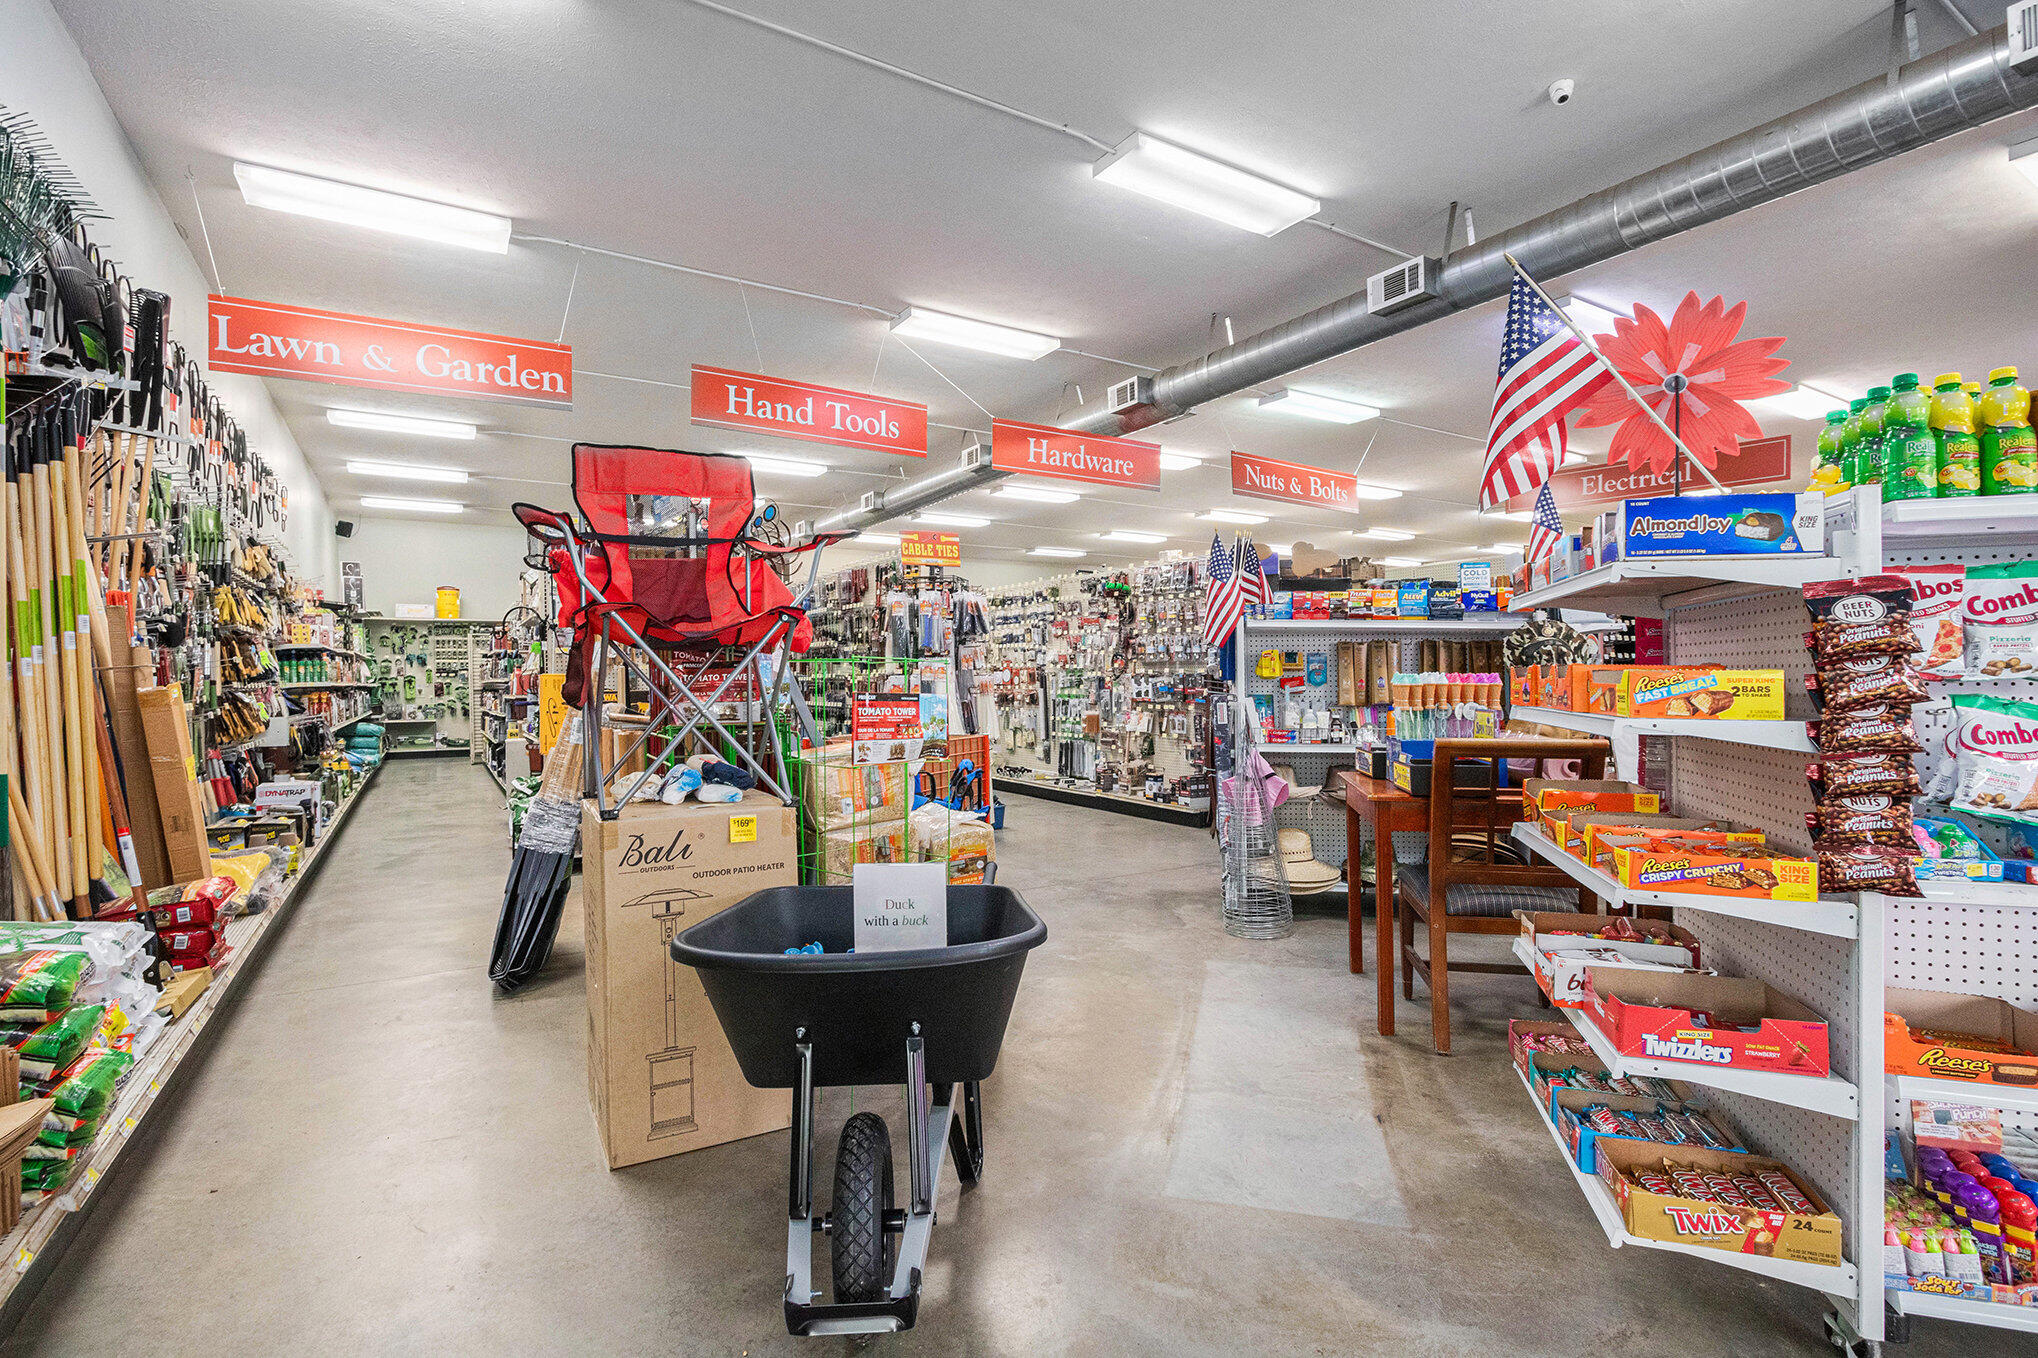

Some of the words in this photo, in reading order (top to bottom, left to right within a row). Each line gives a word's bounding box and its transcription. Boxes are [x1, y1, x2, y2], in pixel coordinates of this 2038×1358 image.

[211, 314, 342, 367] Lawn
[361, 345, 398, 373] &
[415, 343, 568, 394] Garden
[725, 384, 815, 427] Hand
[825, 401, 900, 440] Tools
[1027, 437, 1134, 477] Hardware
[1243, 463, 1285, 492] Nuts
[1289, 475, 1304, 494] &
[1308, 476, 1349, 503] Bolts
[1580, 462, 1692, 497] Electrical
[1630, 515, 1700, 537] Almond
[1699, 514, 1733, 535] Joy
[902, 542, 934, 556] CABLE
[935, 544, 959, 557] TIES
[1911, 577, 1964, 601] bos
[1842, 601, 1873, 611] BEER
[1844, 607, 1876, 619] NUTS
[1925, 603, 1951, 616] SNACKS
[1839, 626, 1892, 644] Peanuts
[1845, 624, 1877, 635] Original
[1635, 672, 1687, 694] Reese's
[1850, 674, 1900, 692] Peanuts
[1854, 672, 1886, 683] Original
[1635, 687, 1669, 703] FAST
[1670, 676, 1717, 696] BREAK
[1732, 686, 1741, 697] 2
[857, 707, 892, 716] TOMATO
[893, 707, 917, 716] TOWER
[1845, 722, 1895, 737] Peanuts
[1851, 718, 1882, 728] Original
[1847, 769, 1897, 785] Peanuts
[1853, 766, 1883, 776] Original
[265, 789, 306, 797] DYNATRAP
[1850, 796, 1880, 808] NUTS
[1844, 818, 1894, 832] Peanuts
[1850, 814, 1882, 824] Original
[1733, 836, 1760, 844] KING
[618, 829, 694, 868] Bali
[639, 865, 675, 873] OUTDOORS
[692, 867, 732, 879] OUTDOOR
[732, 865, 755, 875] PATIO
[757, 862, 785, 872] HEATER
[1640, 870, 1682, 884] CRISPY
[1683, 863, 1741, 879] CRUNCHY
[1641, 858, 1691, 875] Reese's
[1779, 865, 1810, 875] KING
[1845, 866, 1896, 881] Peanuts
[1852, 862, 1882, 873] Original
[1779, 874, 1810, 885] SIZE
[885, 898, 915, 910] Duck
[864, 915, 889, 926] with
[892, 917, 899, 926] a
[902, 915, 929, 926] buck
[1641, 1033, 1733, 1064] Twizzlers
[1745, 1050, 1781, 1058] STRAWBERRY
[1918, 1048, 1993, 1073] Reese's
[1952, 1108, 1988, 1120] PUNCH
[1792, 1218, 1814, 1232] 24
